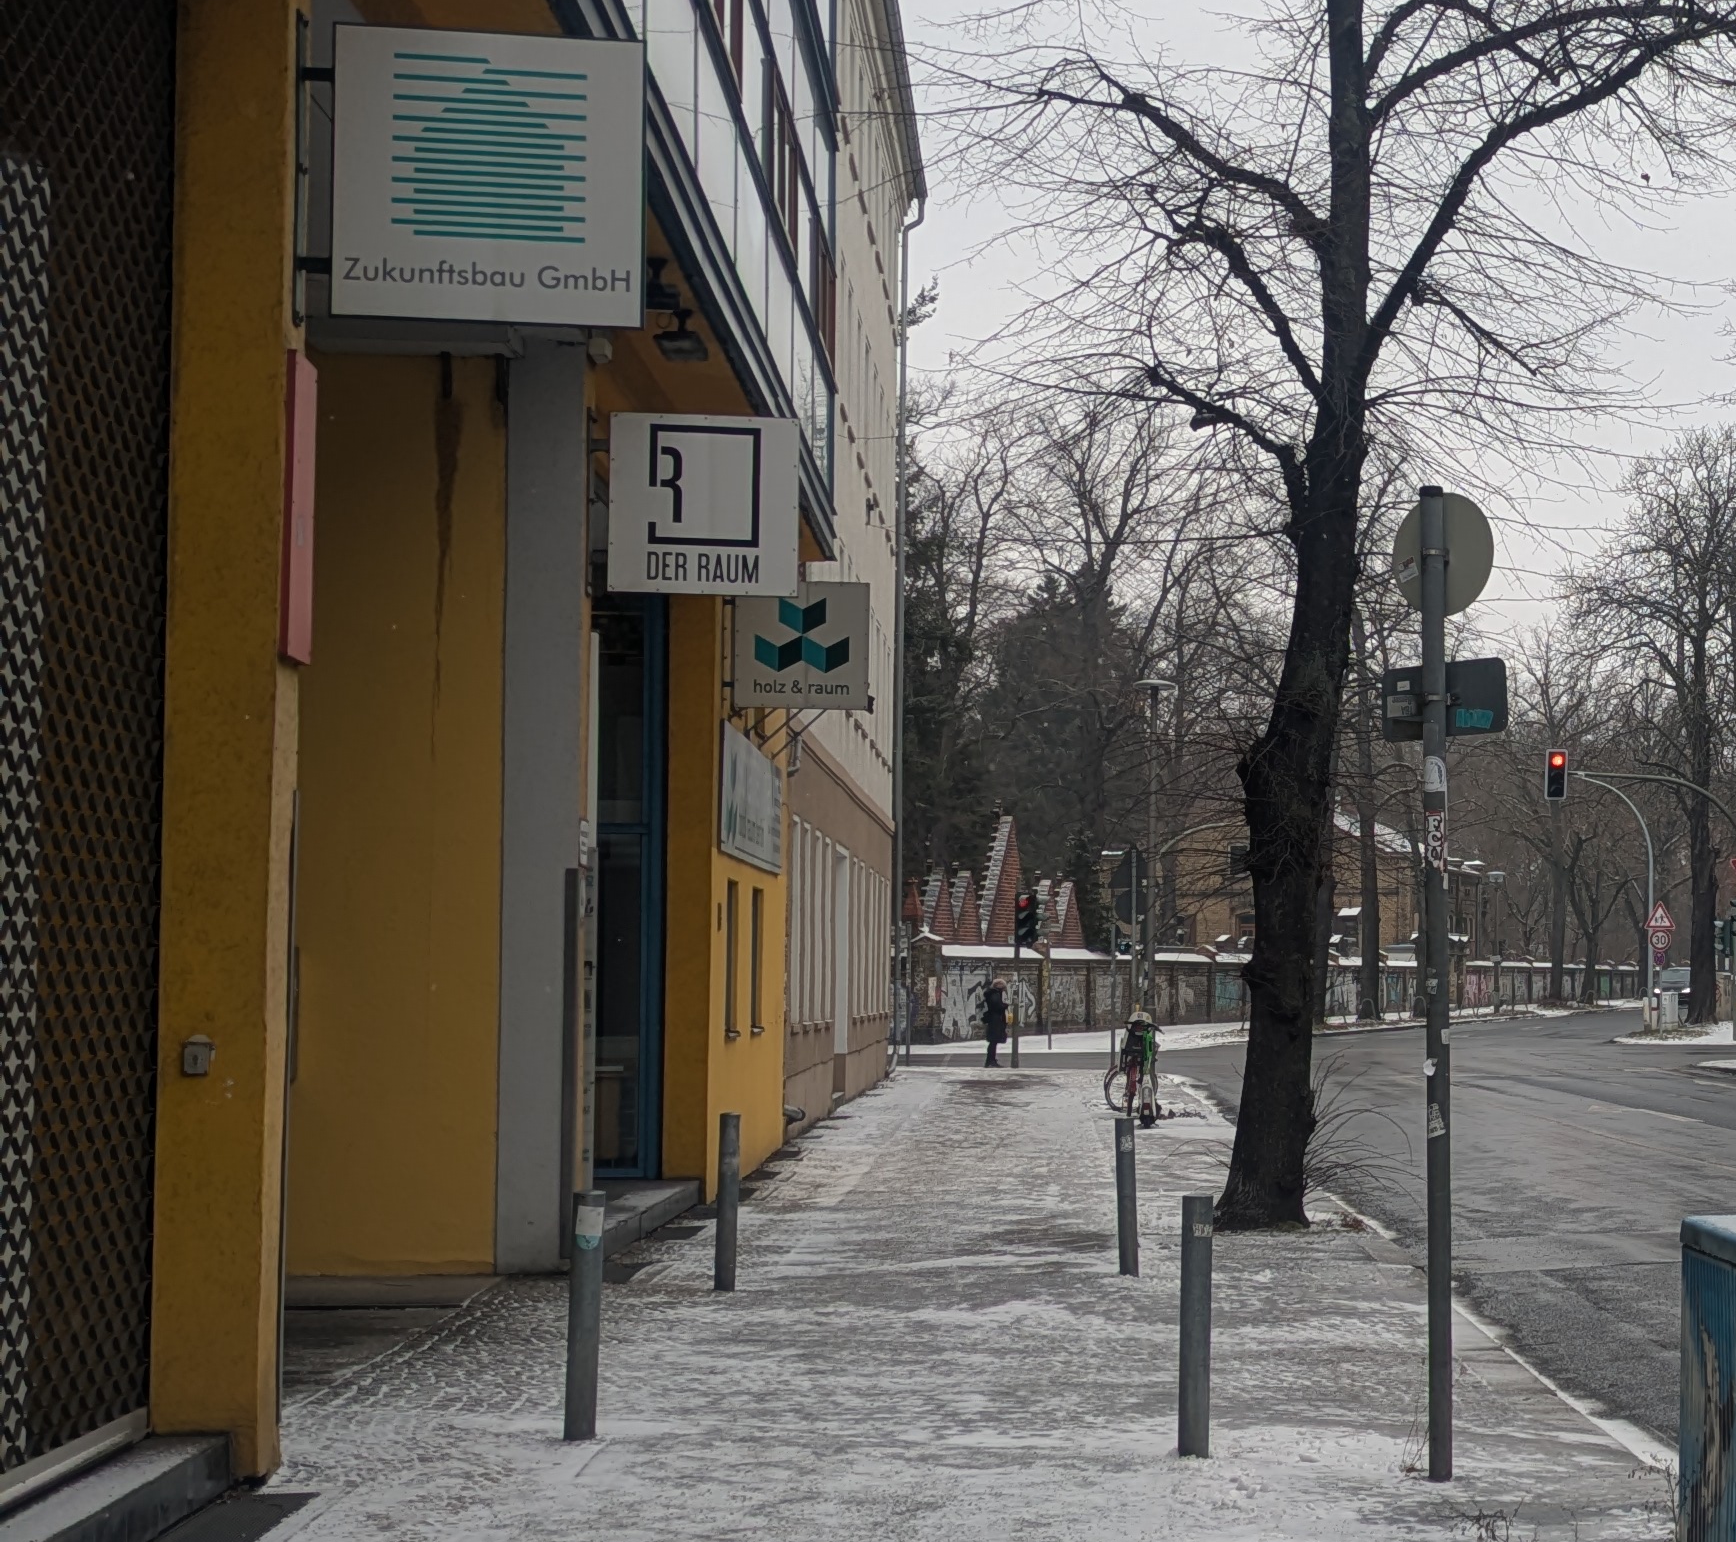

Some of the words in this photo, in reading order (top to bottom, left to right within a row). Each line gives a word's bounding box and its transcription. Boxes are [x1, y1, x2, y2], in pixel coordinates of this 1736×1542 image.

[343, 257, 525, 288] Zukunftsbau
[537, 265, 631, 293] GmbH
[646, 551, 688, 581] DER
[697, 553, 760, 584] RAUM
[753, 679, 786, 694] holz
[791, 680, 803, 694] &
[808, 682, 850, 695] raum
[1653, 934, 1667, 945] 30
